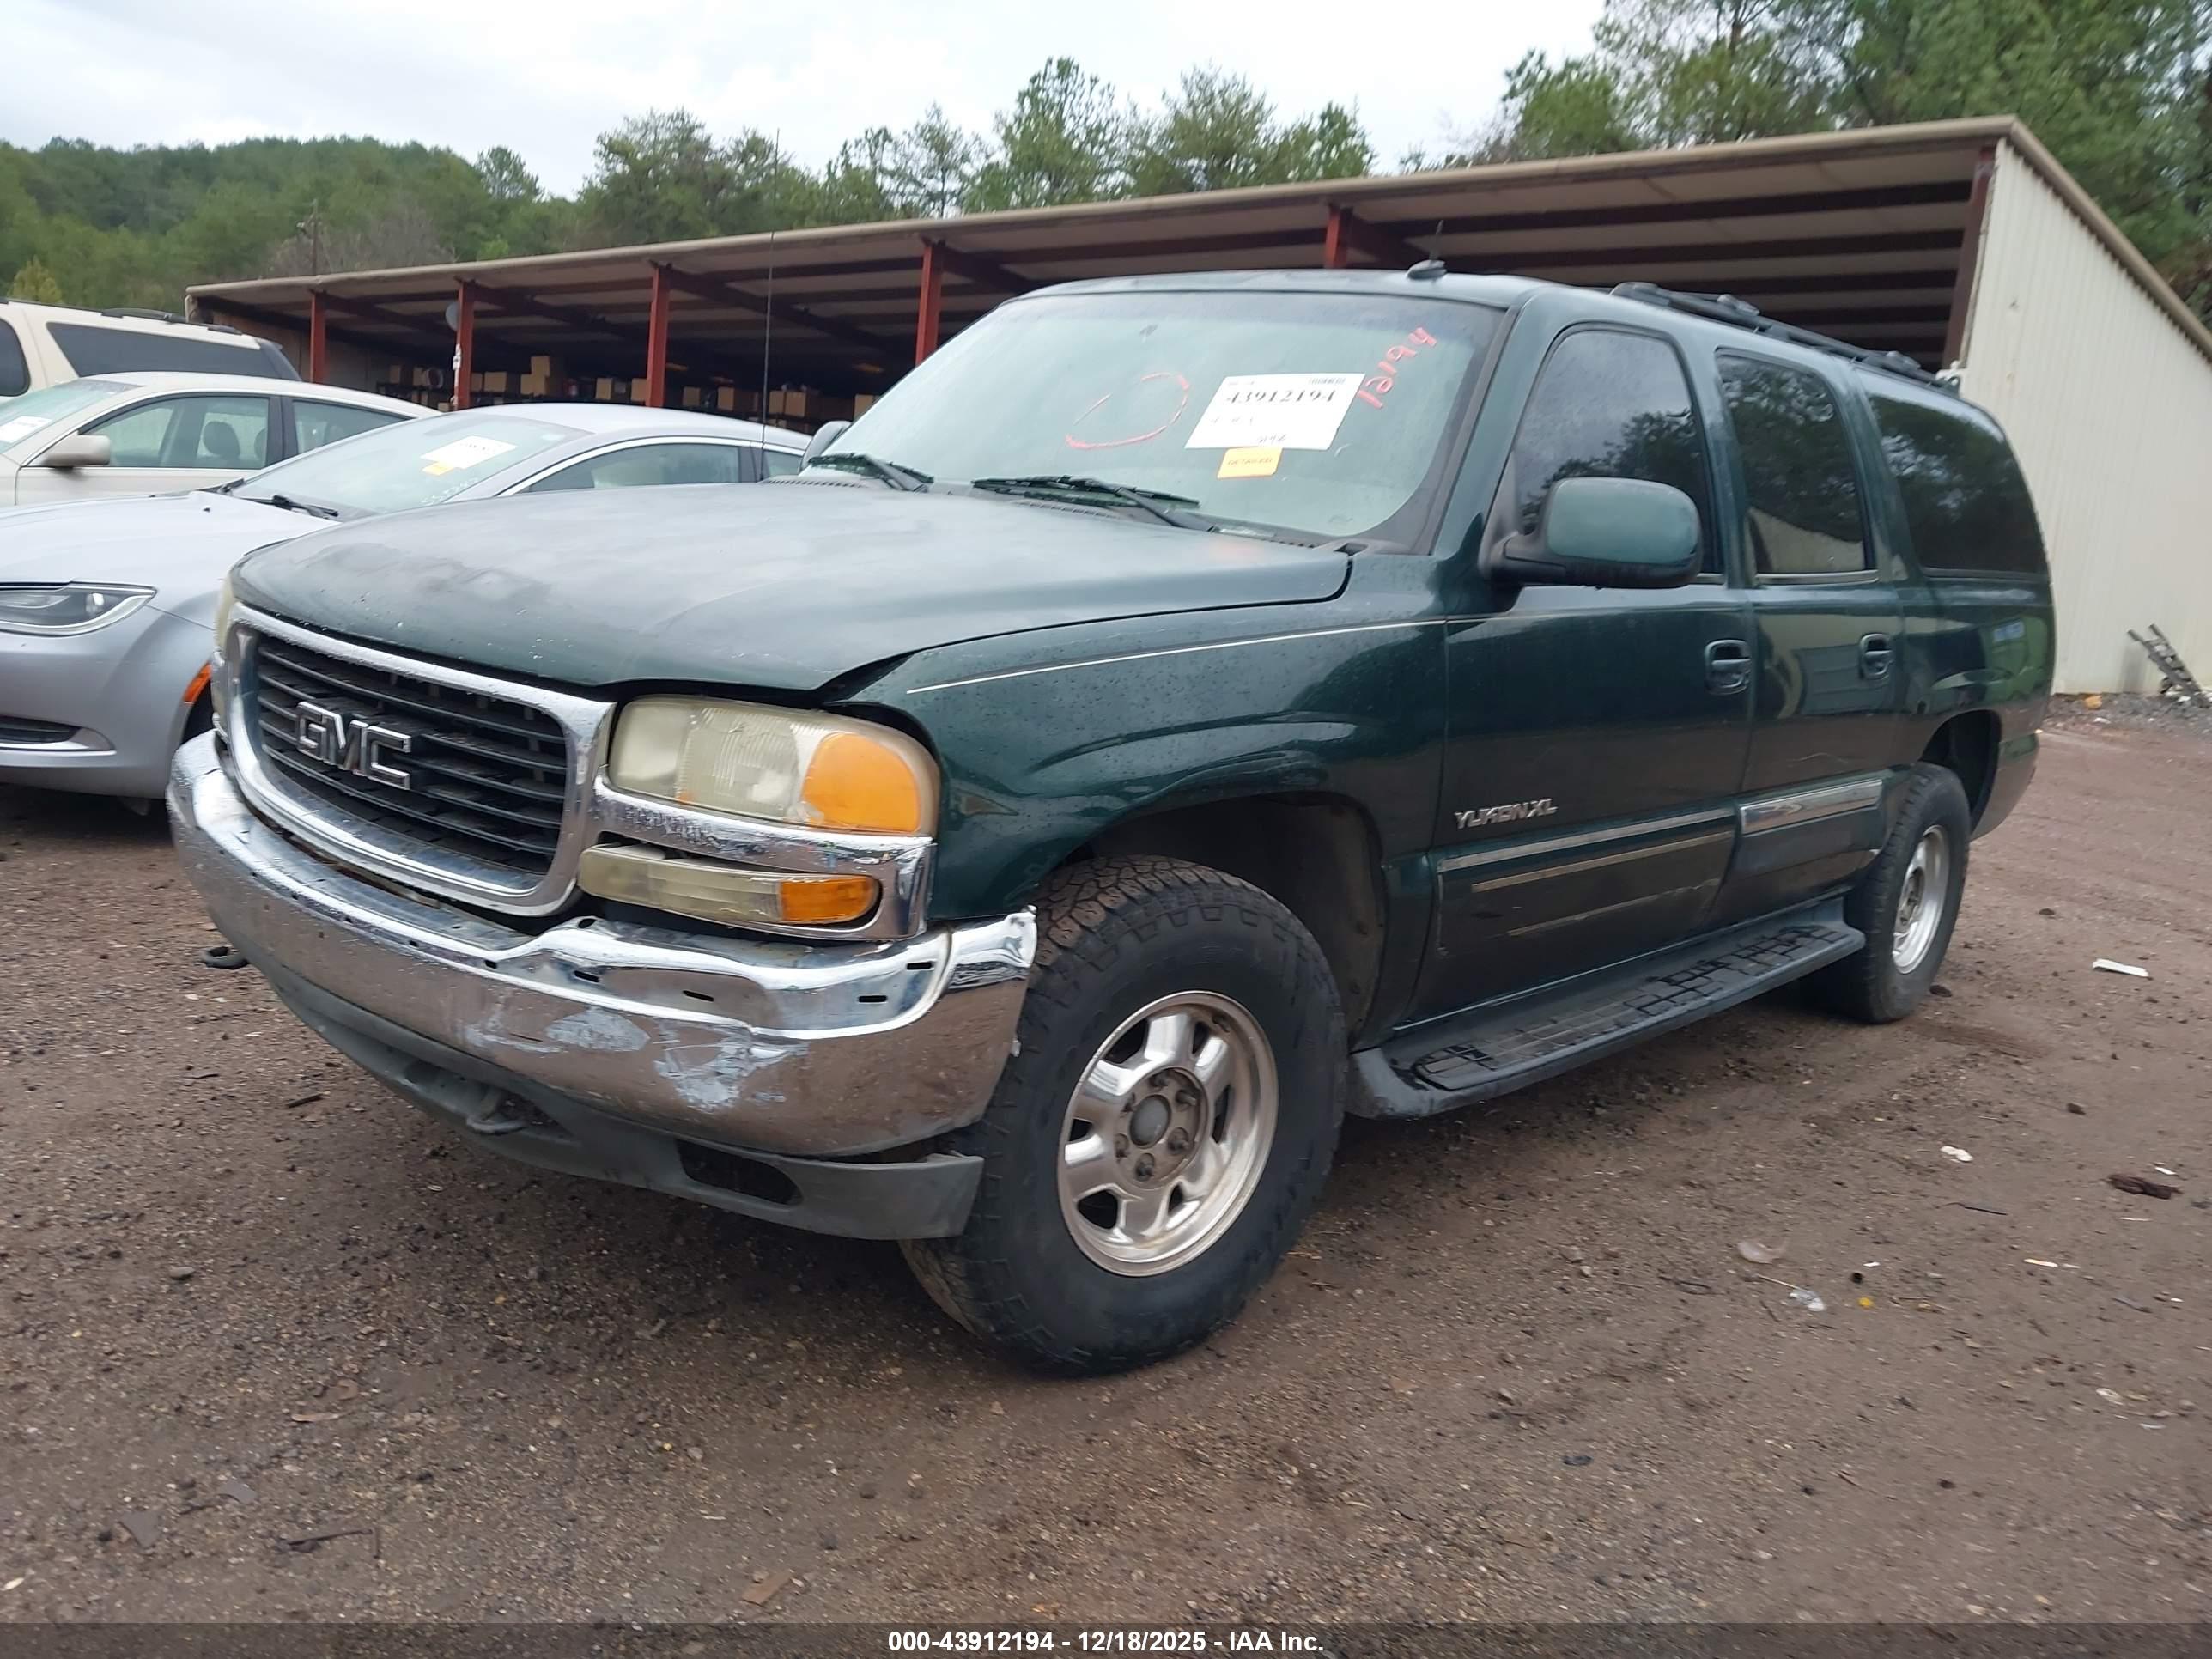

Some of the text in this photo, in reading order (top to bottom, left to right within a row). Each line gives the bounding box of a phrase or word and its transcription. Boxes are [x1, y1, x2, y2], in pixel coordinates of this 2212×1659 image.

[1225, 389, 1337, 404] 43912194
[296, 701, 412, 791] GMC
[1454, 798, 1559, 830] YUKON XL
